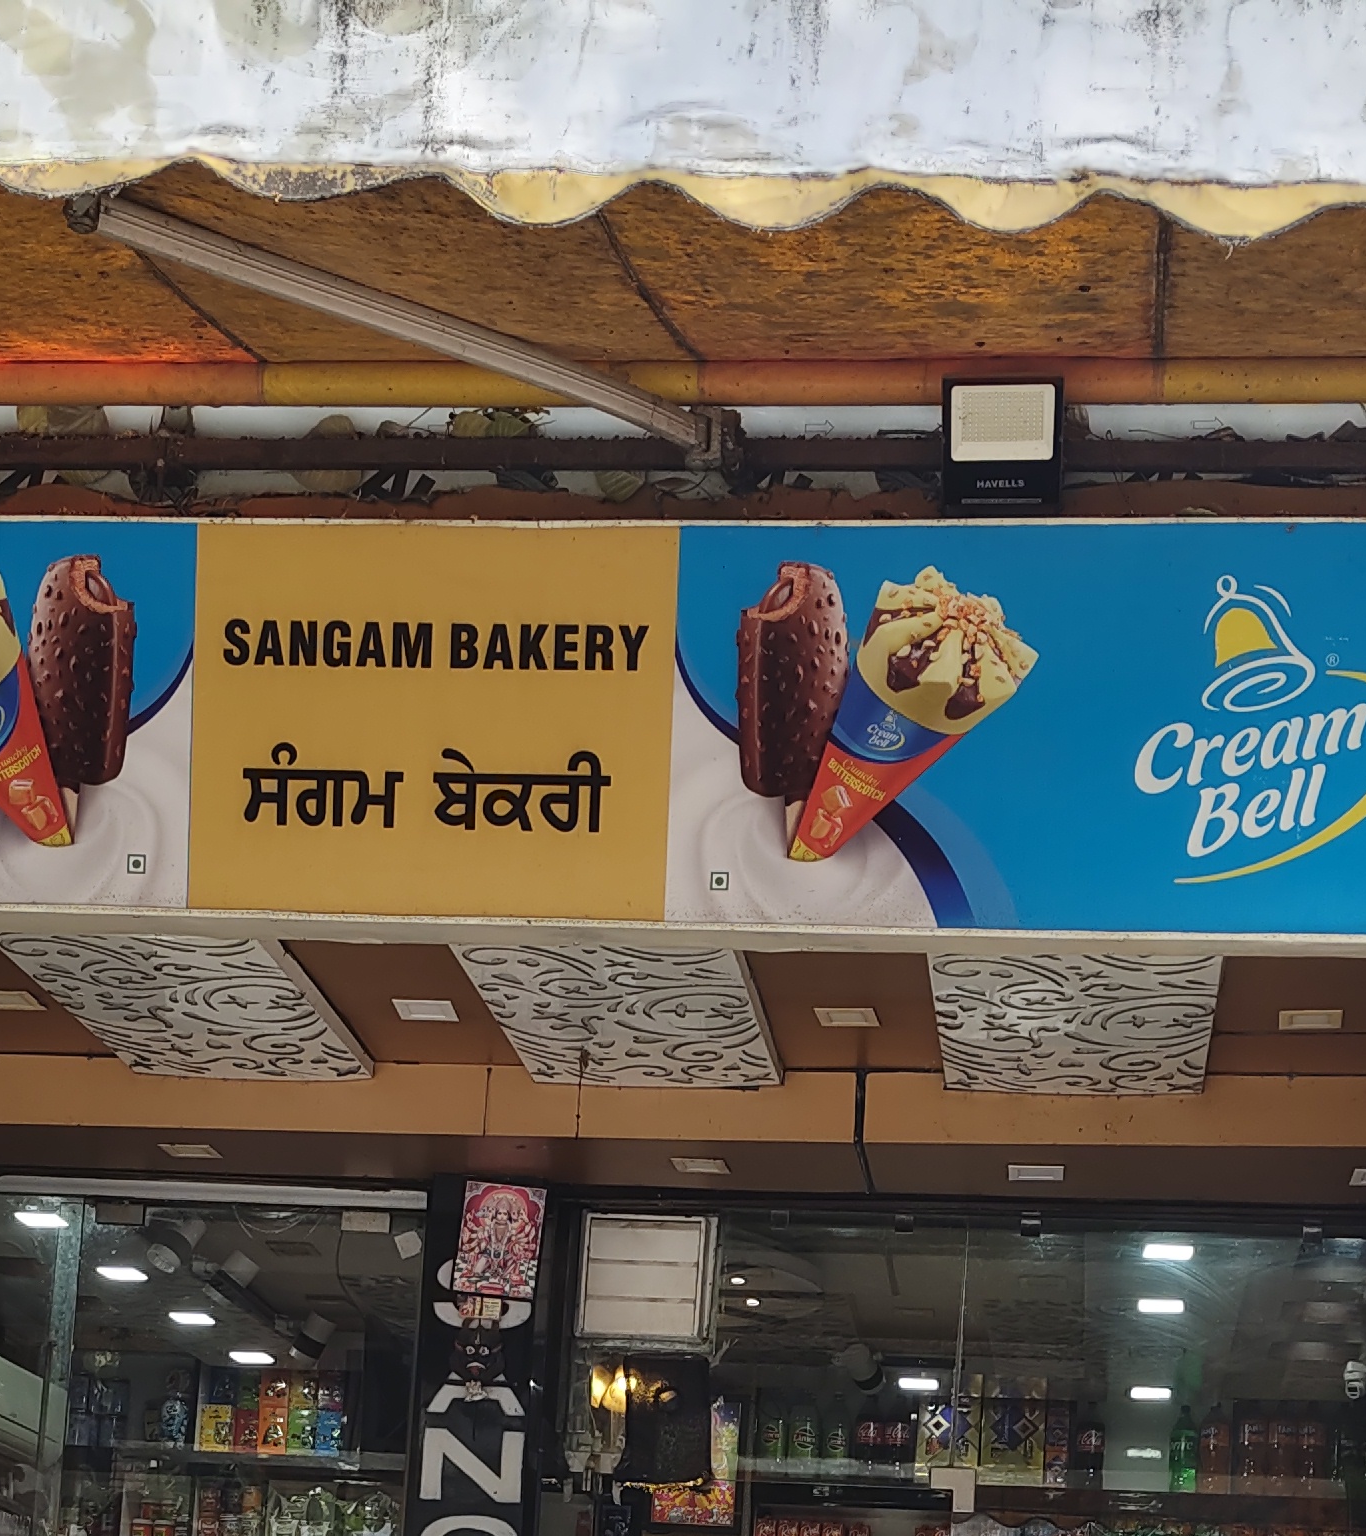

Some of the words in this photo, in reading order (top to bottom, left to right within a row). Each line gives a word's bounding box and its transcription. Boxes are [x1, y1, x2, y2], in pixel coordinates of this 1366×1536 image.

[976, 479, 1025, 489] HAVELLS
[222, 618, 433, 669] SANGAM
[450, 623, 650, 671] BAKERY
[242, 742, 404, 829] ਸੰਗਮ
[433, 748, 611, 833] ਬੇਕਰੀ
[1186, 764, 1327, 859] Bell
